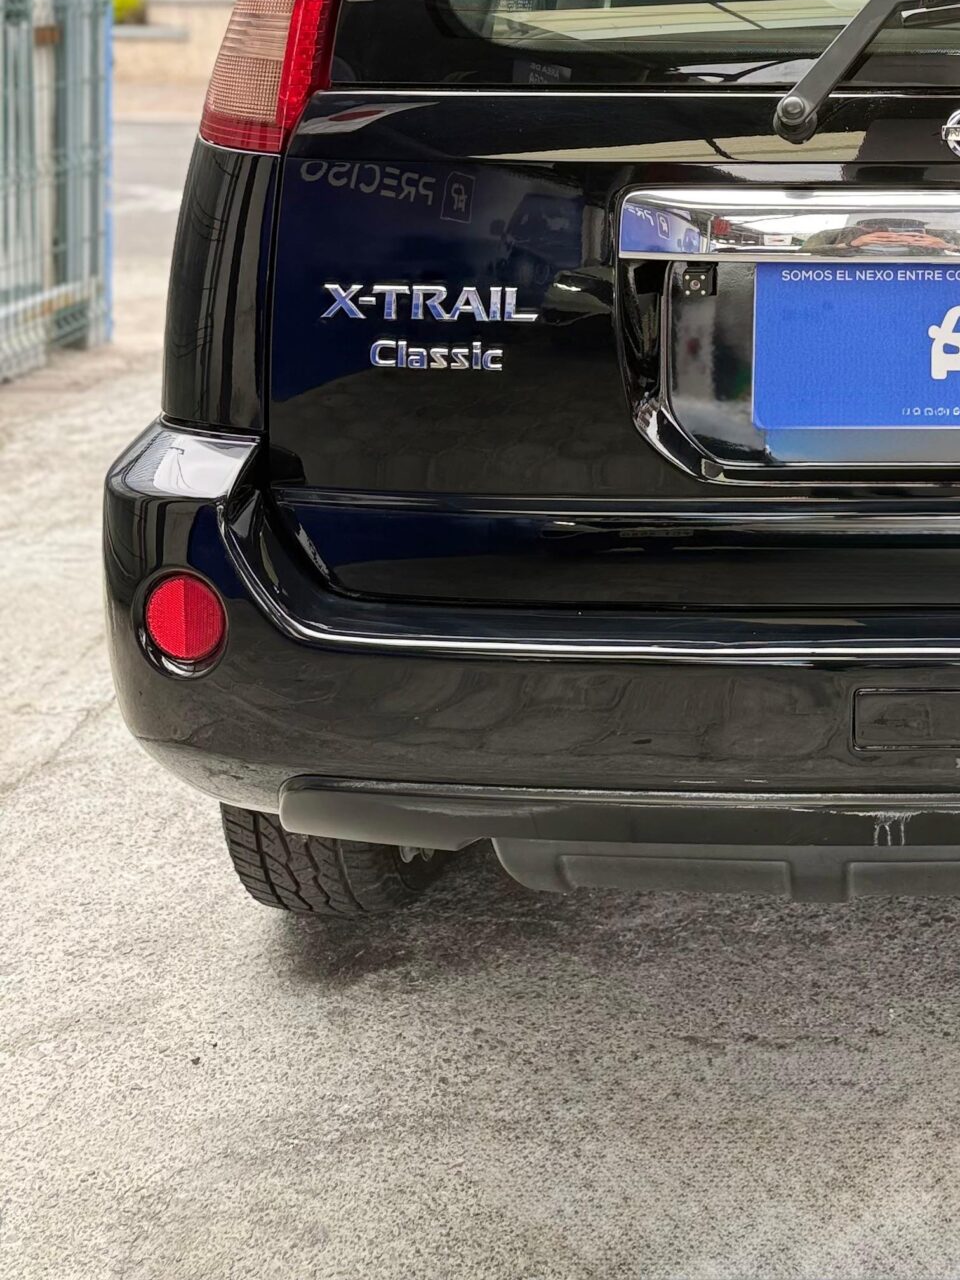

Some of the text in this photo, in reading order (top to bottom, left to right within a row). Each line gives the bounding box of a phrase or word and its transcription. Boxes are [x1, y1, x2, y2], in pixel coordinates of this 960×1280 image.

[781, 269, 833, 281] SOMOS
[836, 269, 851, 281] EL
[855, 269, 894, 281] NEXO
[897, 269, 943, 281] ENTRE
[320, 283, 539, 322] X-TRAIL
[369, 339, 504, 371] Classic
